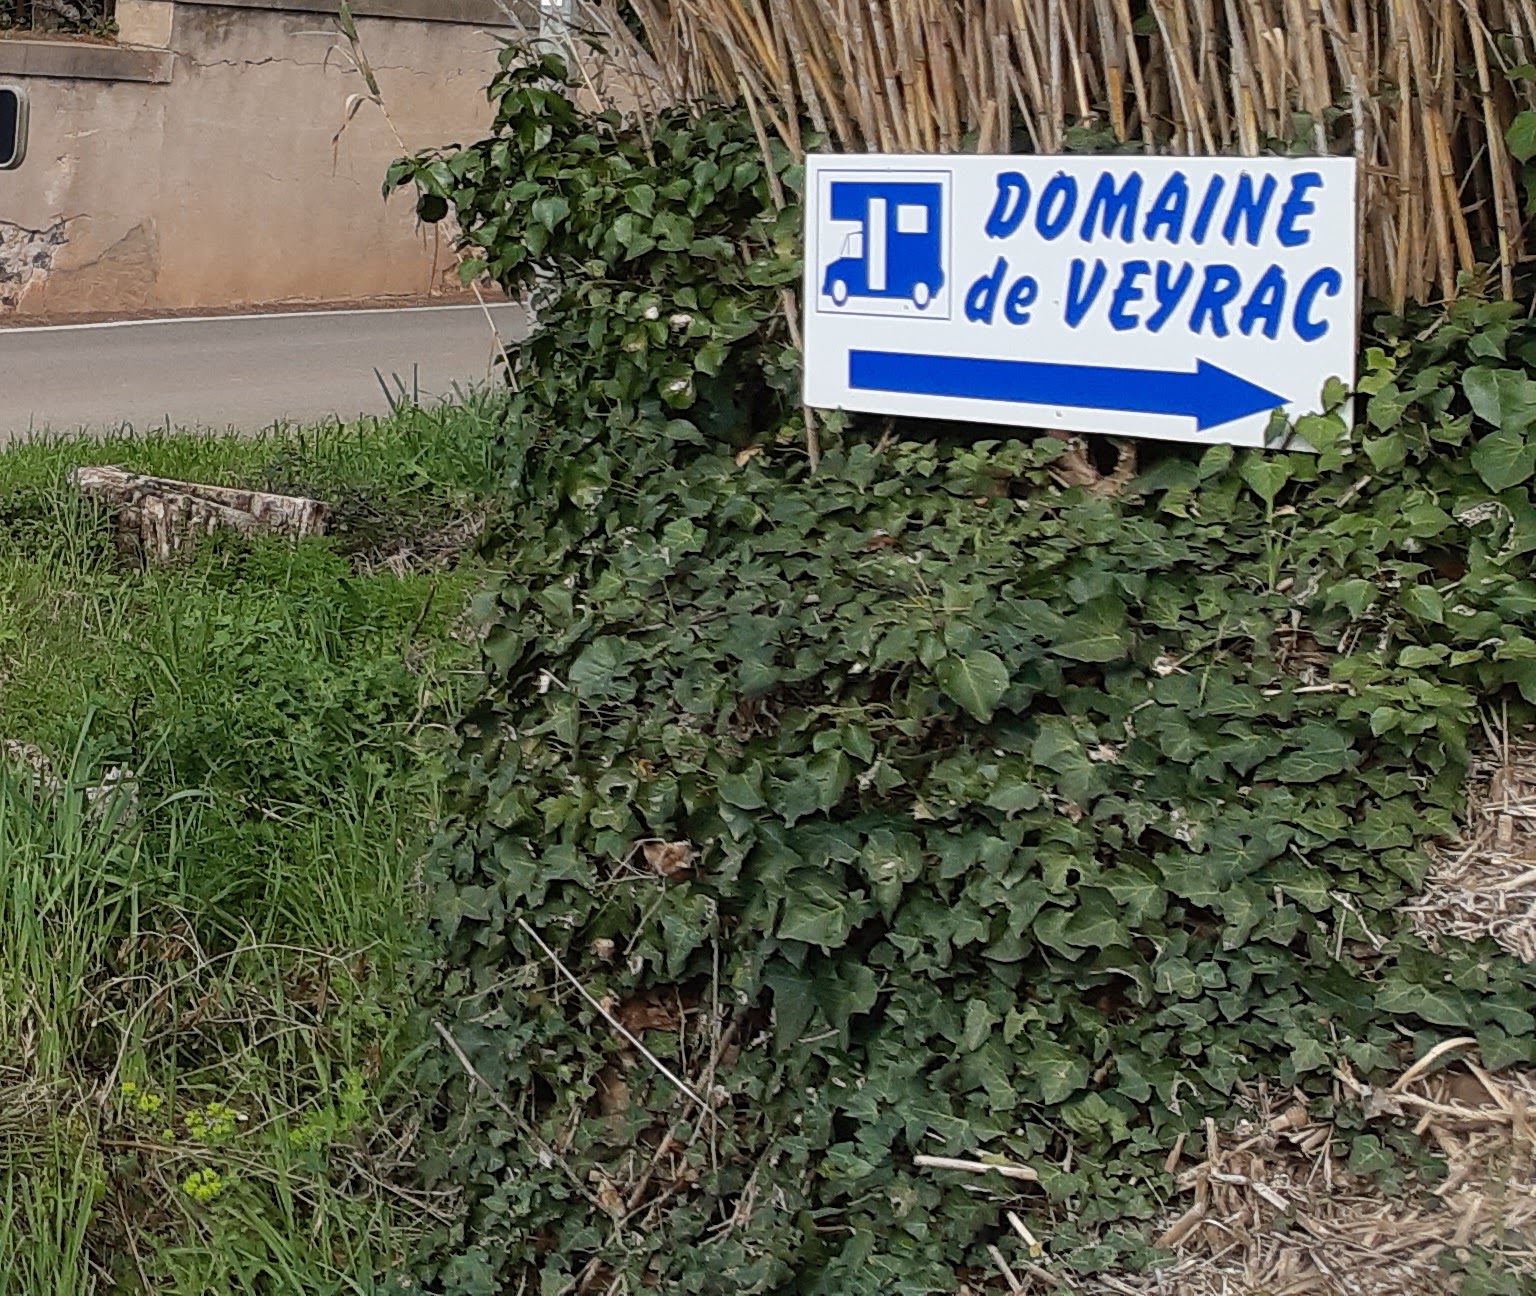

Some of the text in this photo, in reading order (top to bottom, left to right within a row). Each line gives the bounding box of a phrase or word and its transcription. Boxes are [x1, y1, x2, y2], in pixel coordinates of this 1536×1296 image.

[985, 171, 1323, 247] DOMAINE
[964, 256, 1342, 342] de VEYRAC
